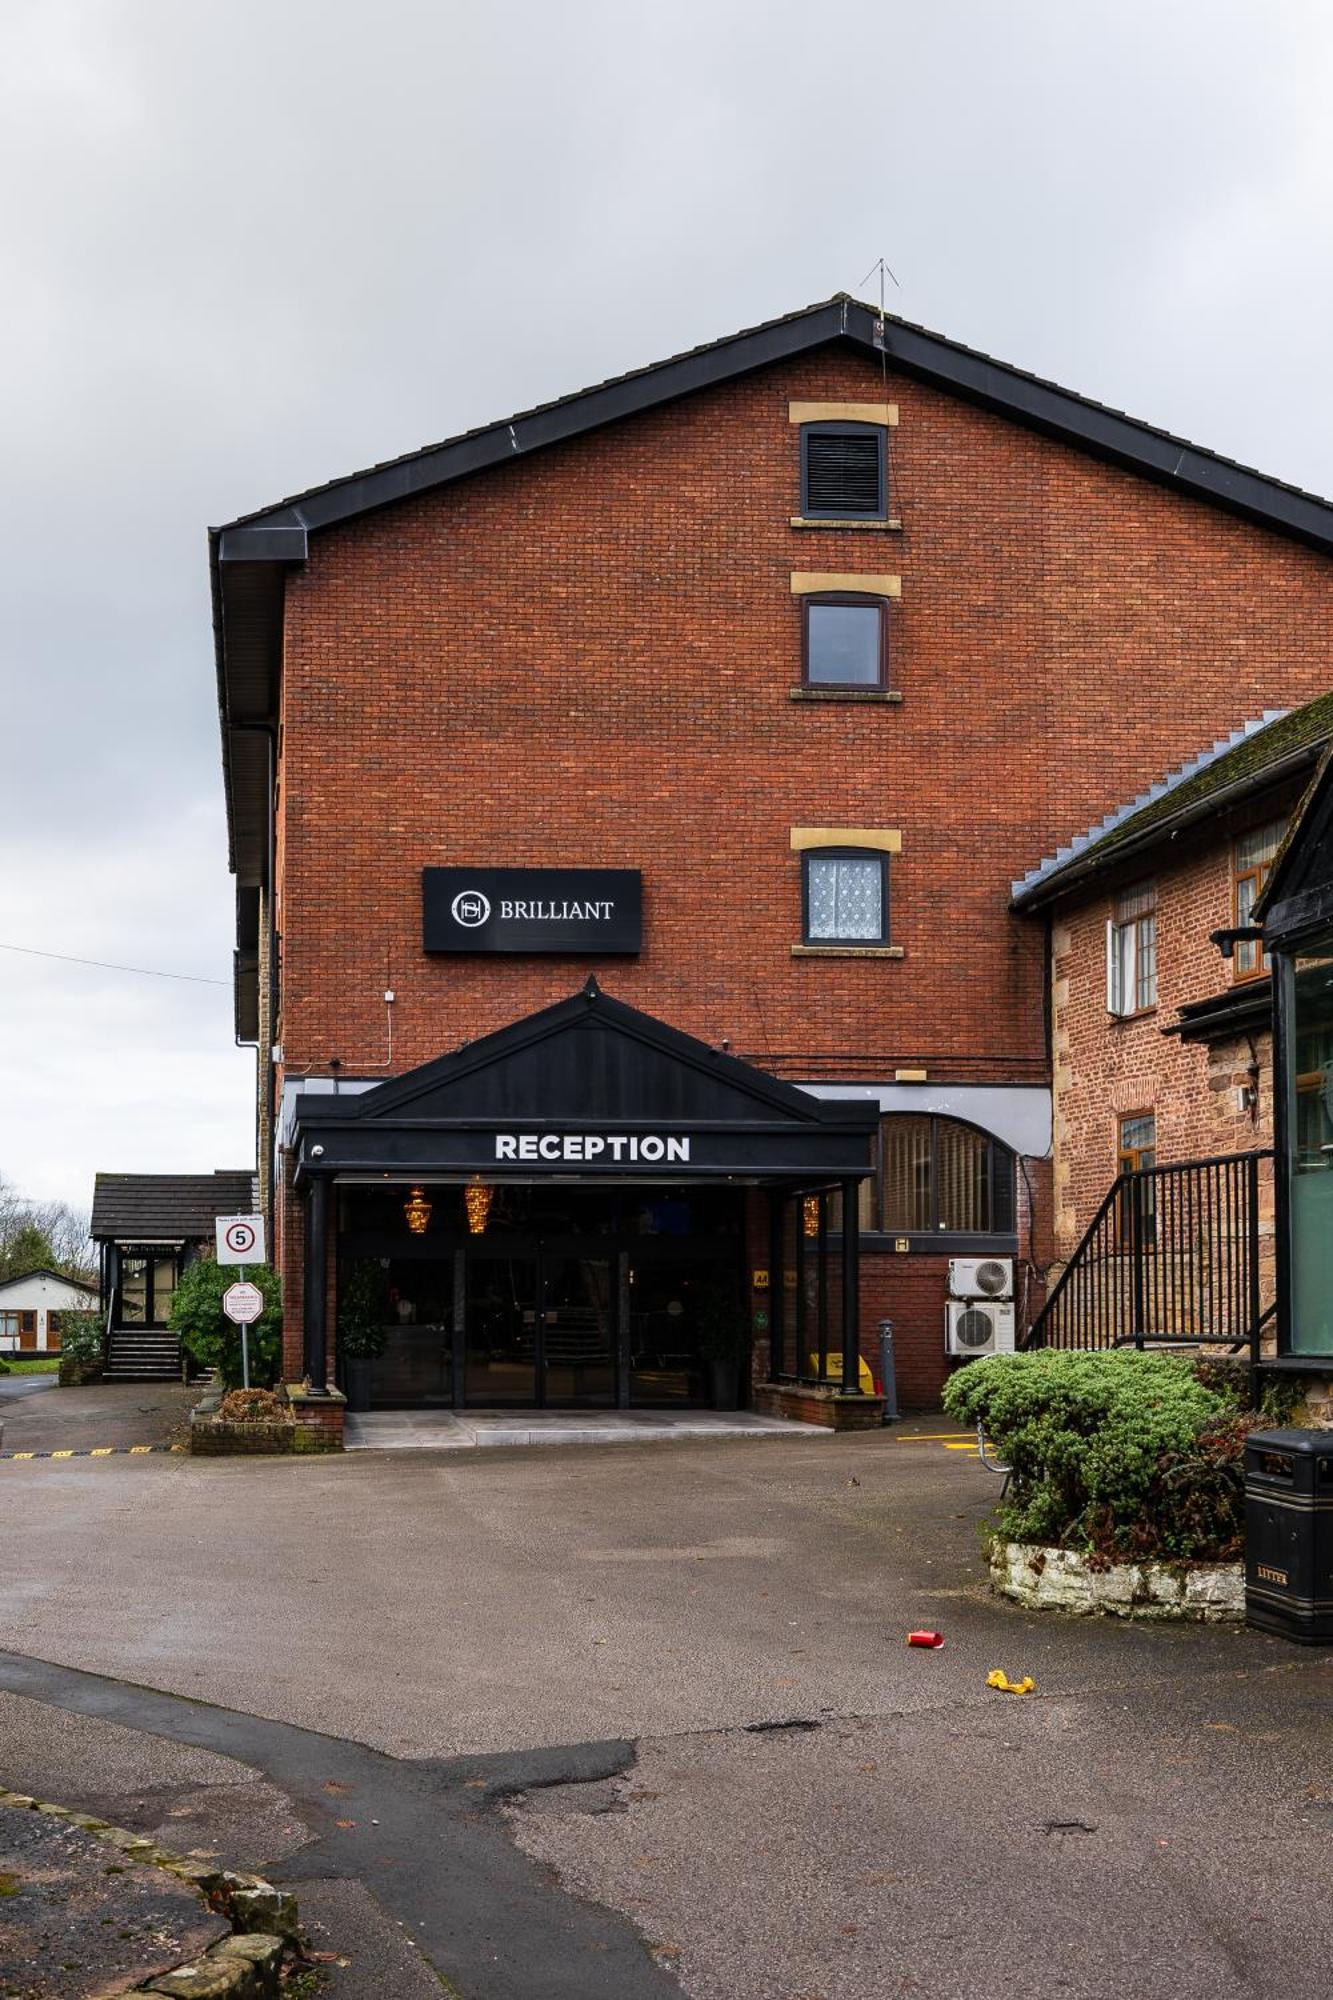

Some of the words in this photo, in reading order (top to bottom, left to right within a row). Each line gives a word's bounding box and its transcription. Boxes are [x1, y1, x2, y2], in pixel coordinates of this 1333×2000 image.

[501, 900, 614, 919] BRILLIANT
[495, 1135, 690, 1161] RECEPTION
[235, 1231, 246, 1246] 5
[1257, 1566, 1289, 1585] LITTER
